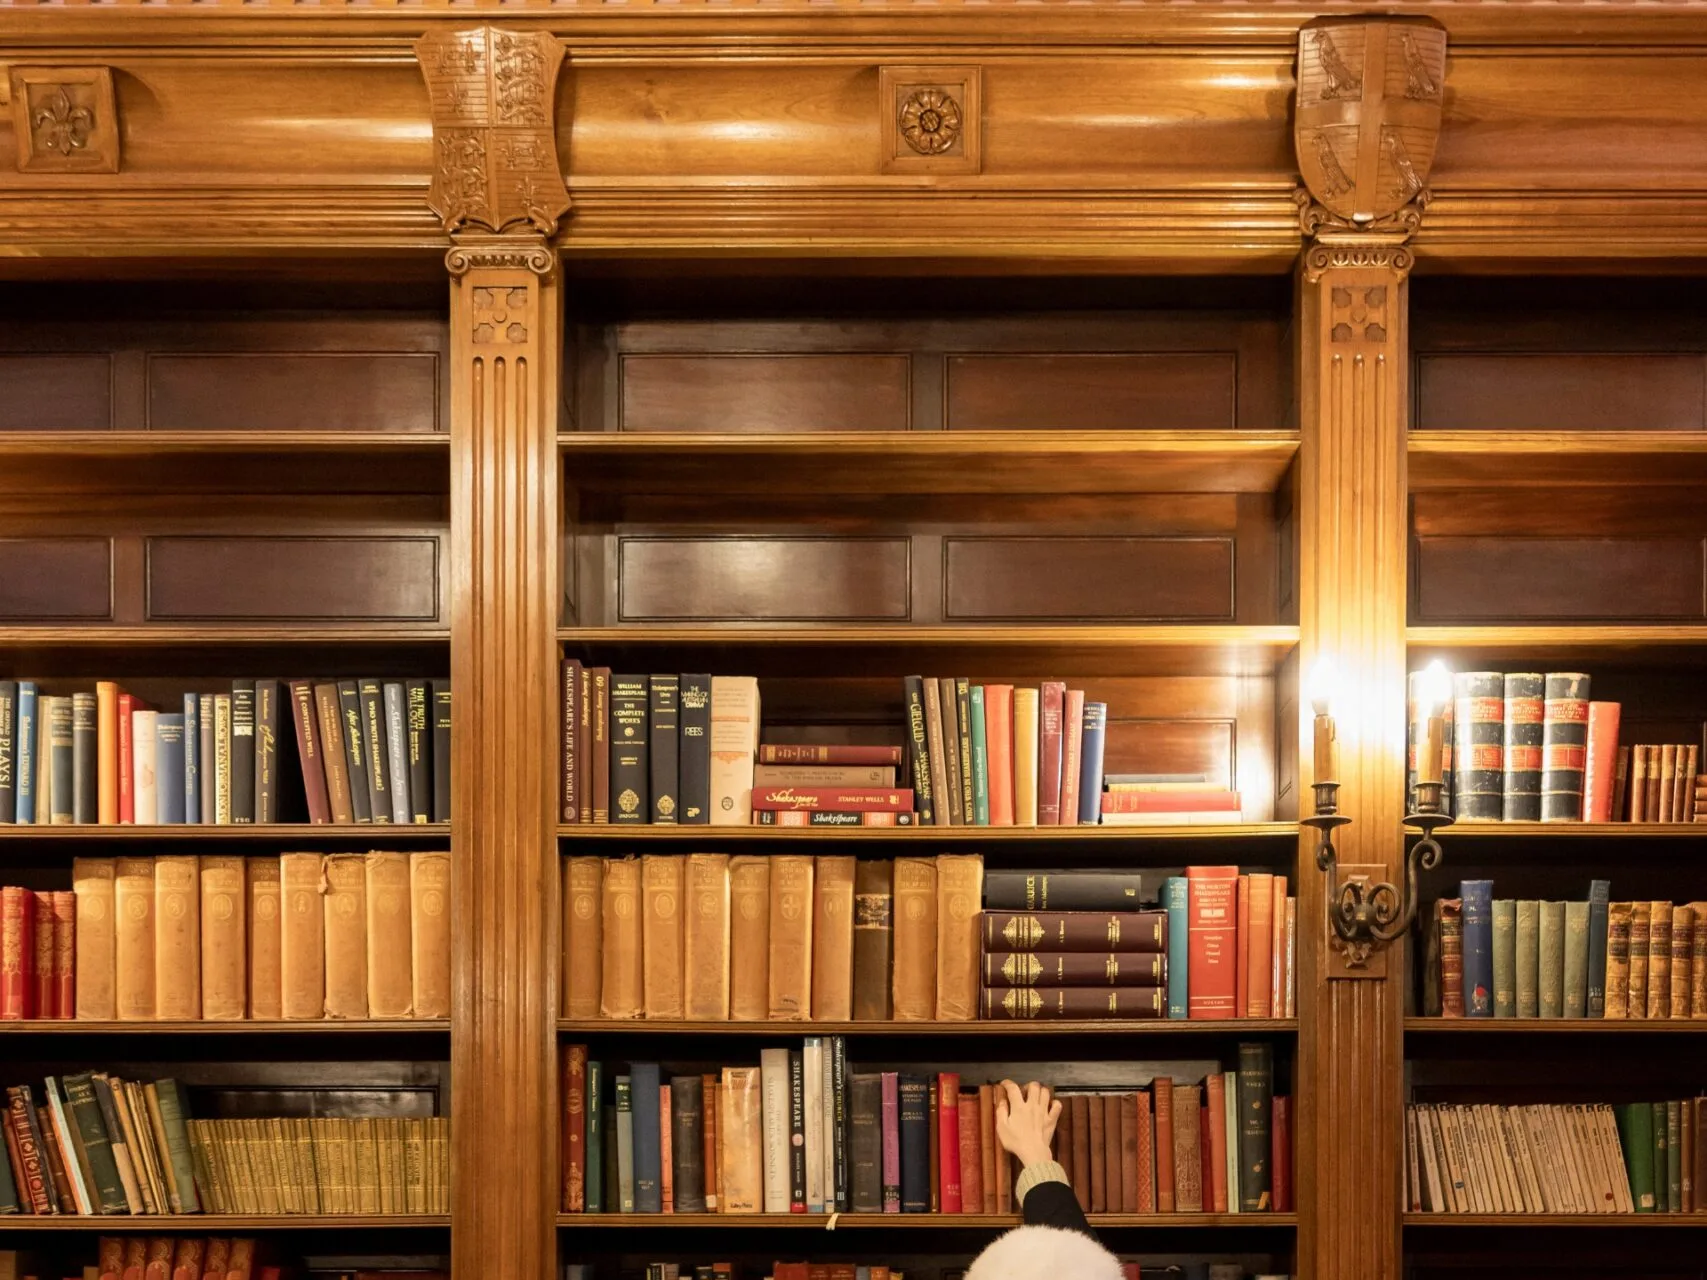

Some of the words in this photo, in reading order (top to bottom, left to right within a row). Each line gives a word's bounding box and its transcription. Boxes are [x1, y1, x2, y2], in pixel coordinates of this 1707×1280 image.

[596, 676, 604, 687] 60
[409, 687, 418, 708] WILL
[416, 687, 425, 701] THE
[566, 667, 574, 730] SHAKESPEARE'S
[347, 709, 358, 726] After
[368, 701, 376, 718] WHO
[409, 710, 418, 730] OUT
[417, 704, 425, 730] TRUTH
[301, 702, 313, 741] CONTESTED
[370, 719, 378, 742] WROTE
[684, 727, 704, 737] REES
[306, 741, 314, 758] WILL
[566, 732, 574, 750] LIFE
[910, 703, 924, 743] GIELGUD
[918, 751, 931, 800] SHAKESPEARE
[0, 738, 11, 782] PLAYS
[566, 752, 574, 770] AND
[566, 772, 574, 802] WORLD
[766, 788, 818, 809] Shakespeare
[834, 1037, 844, 1089] Shakespeare's
[793, 1061, 801, 1127] SHAKESPEARE
